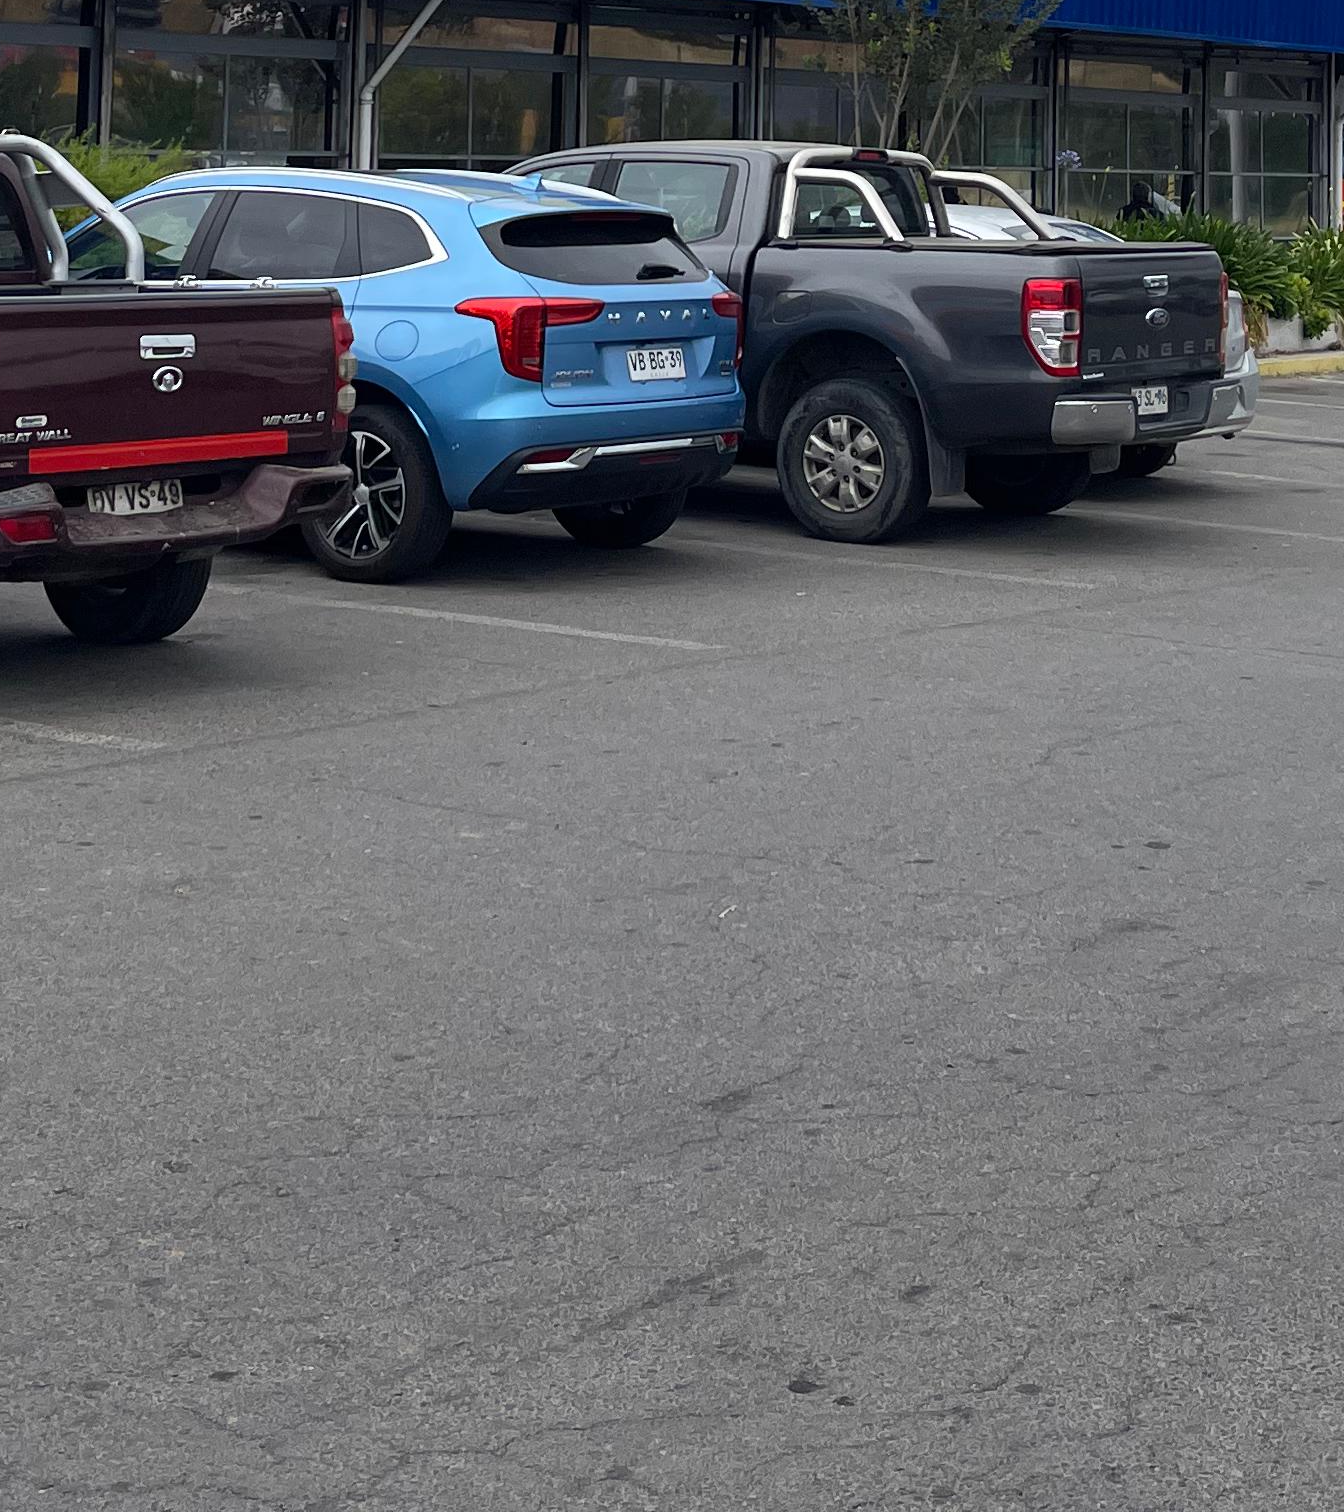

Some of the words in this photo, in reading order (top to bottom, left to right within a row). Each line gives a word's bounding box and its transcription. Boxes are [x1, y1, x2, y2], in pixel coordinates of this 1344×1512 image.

[1087, 338, 1216, 363] RANGER
[262, 412, 313, 426] WINGLE
[36, 428, 72, 441] WALL
